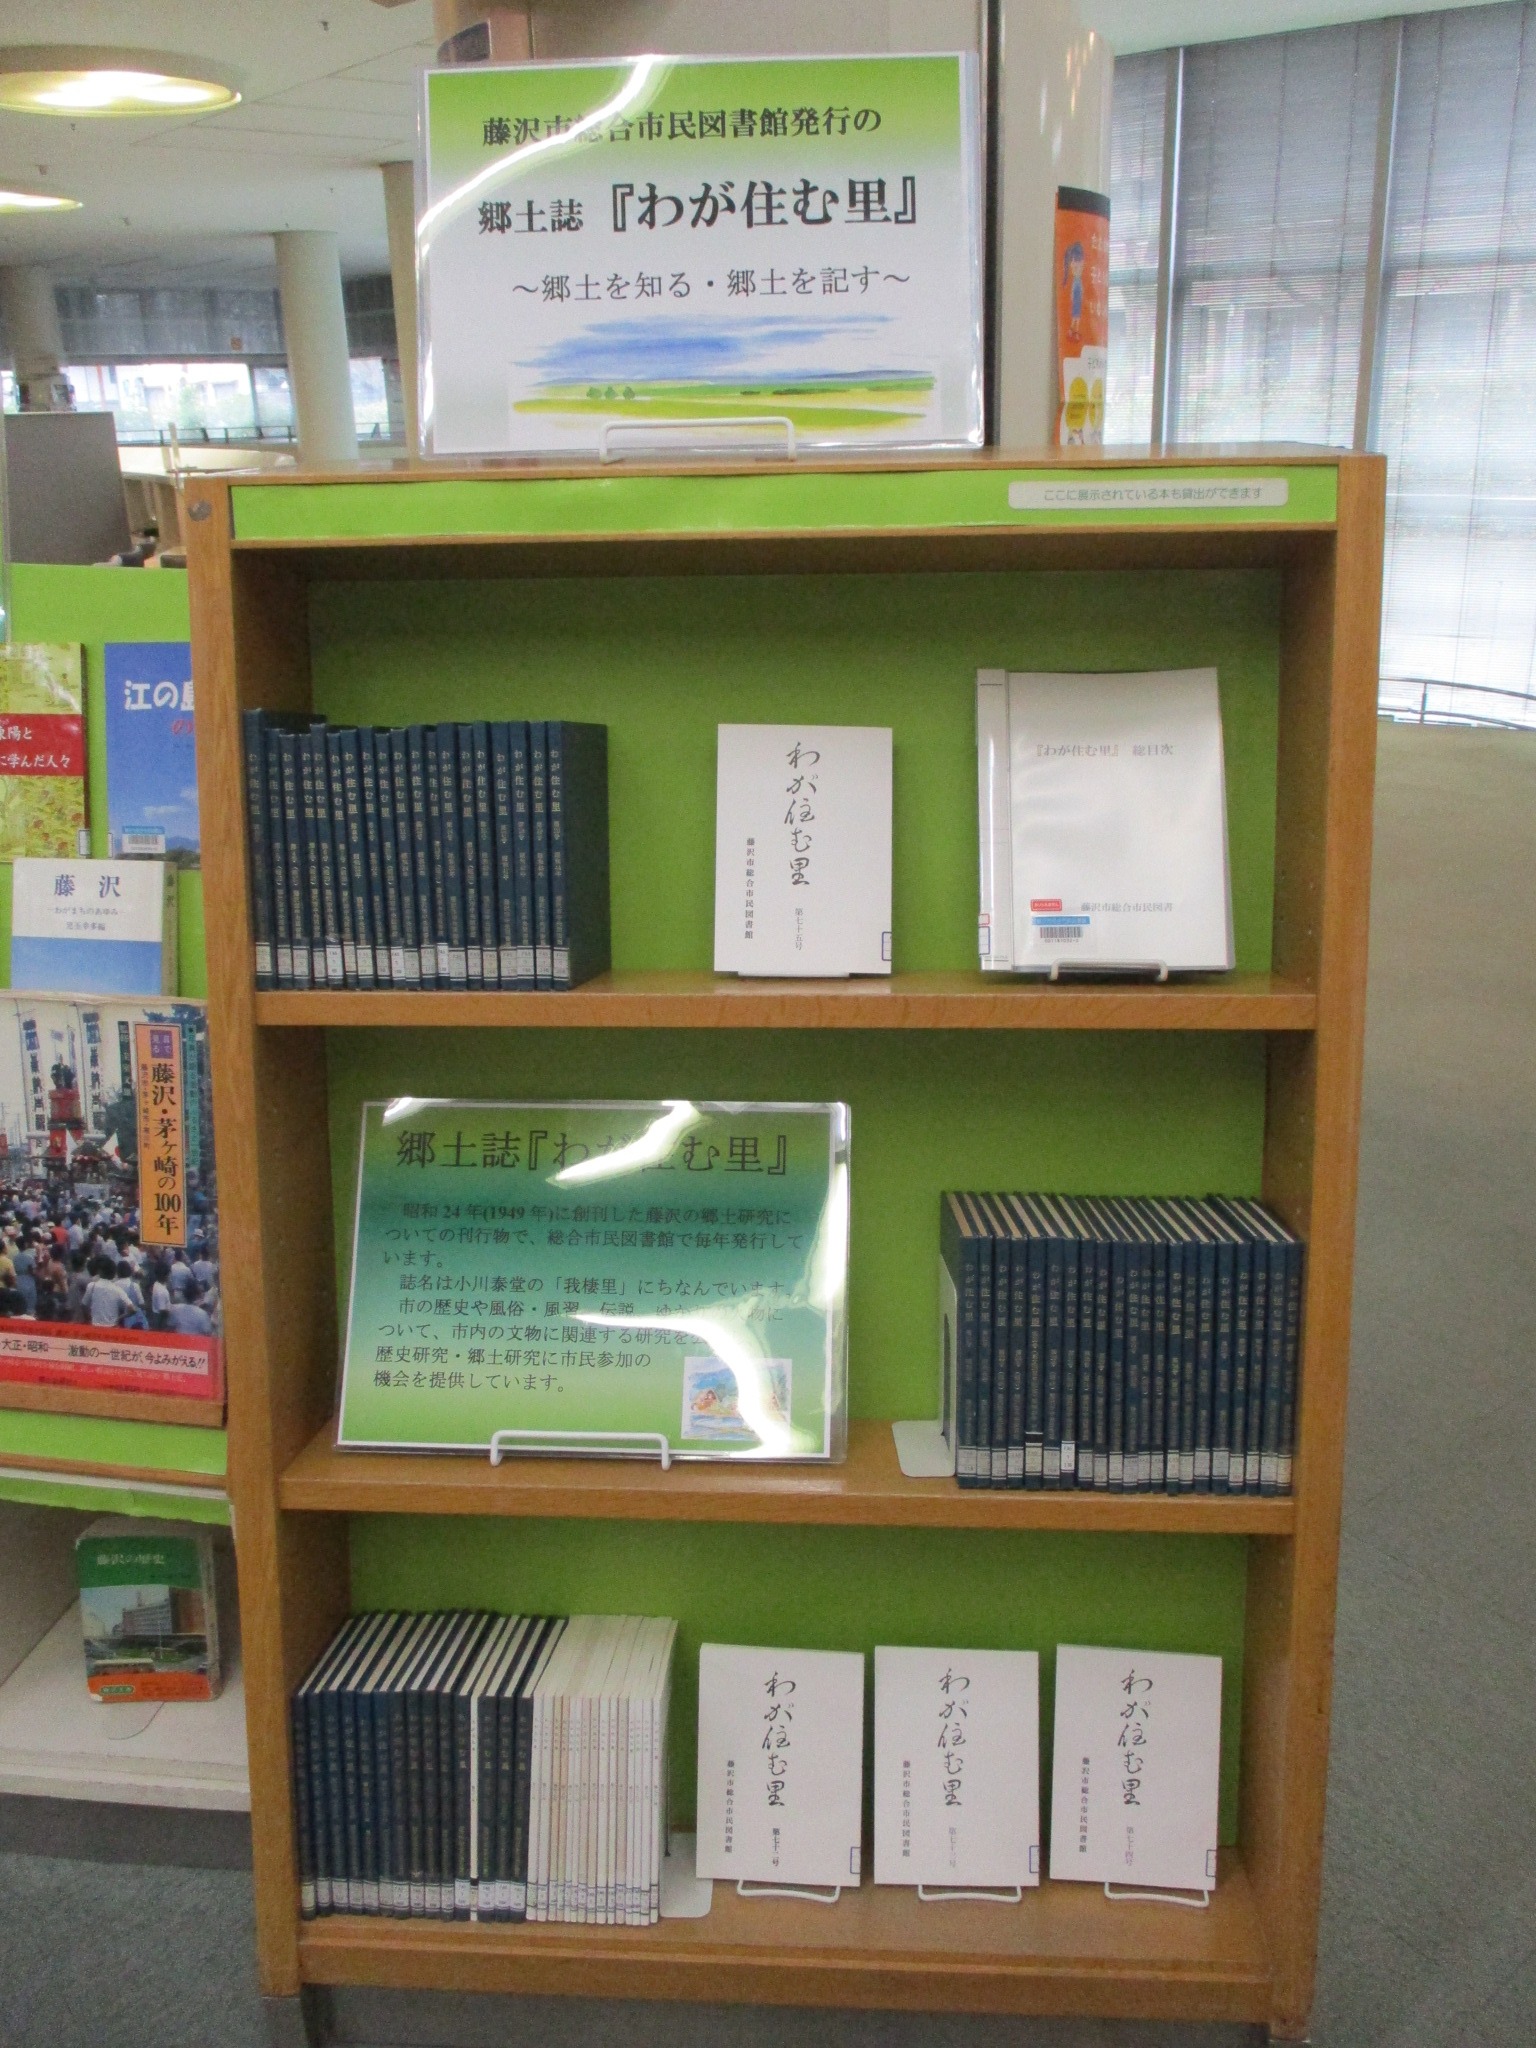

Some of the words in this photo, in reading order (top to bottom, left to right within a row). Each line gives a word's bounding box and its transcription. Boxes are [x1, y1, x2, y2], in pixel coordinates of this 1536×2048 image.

[1044, 487, 1262, 501] ここに展示されている本も貸出ができます
[784, 742, 820, 886] わが住む里
[396, 1129, 788, 1176] 郷土誌『わがむ里』
[385, 1227, 803, 1250] ついての刊行物で、総合市民図書館で毎年発行して
[384, 1250, 443, 1268] います。
[374, 1345, 651, 1369] 歴史研究・郷土研究に市民参加の
[373, 1369, 565, 1393] 機会を提供しています。
[762, 1671, 797, 1806] わが住む里
[937, 1668, 971, 1806] わが住む里
[1117, 1668, 1154, 1806] わが住む里
